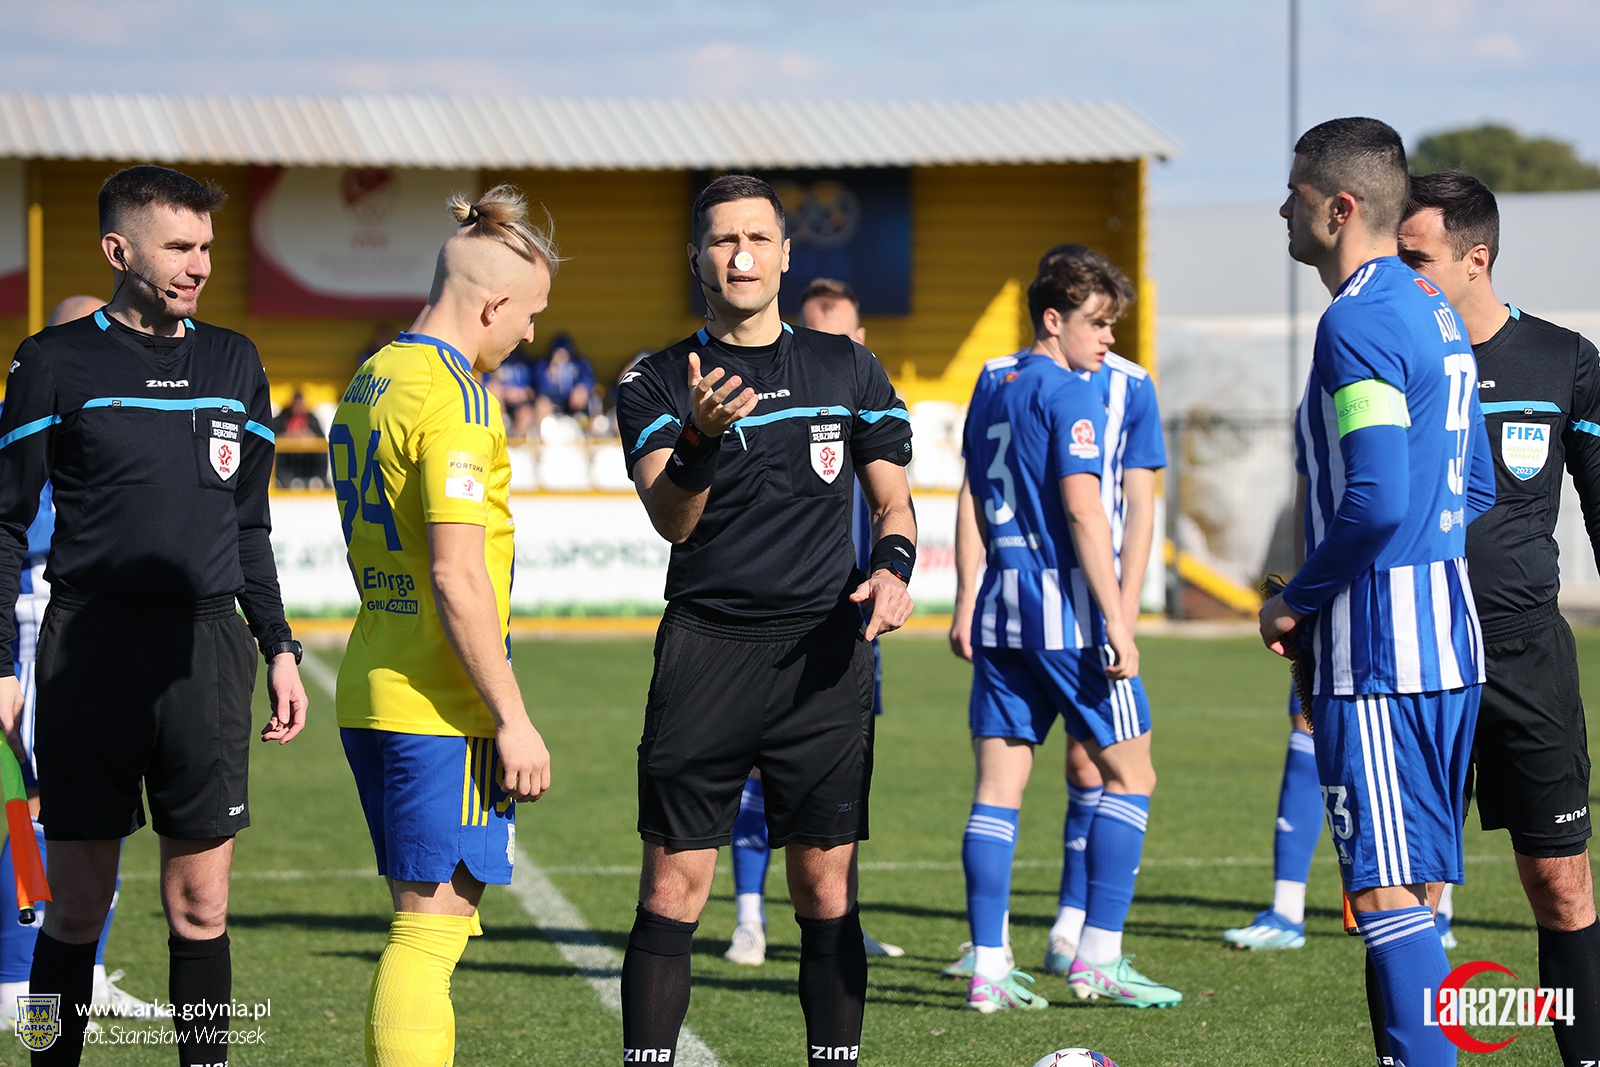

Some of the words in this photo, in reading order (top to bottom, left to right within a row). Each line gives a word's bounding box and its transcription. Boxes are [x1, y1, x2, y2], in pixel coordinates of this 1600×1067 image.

[146, 379, 189, 388] zina
[758, 389, 790, 400] ina
[1338, 399, 1370, 418] RESPECT
[1507, 426, 1544, 442] FIFA
[1506, 446, 1544, 454] ASSISTANT
[1508, 452, 1541, 460] REFEREE
[450, 462, 484, 473] FORTUNA
[985, 422, 1016, 525] 3
[1515, 467, 1533, 475] 2023
[388, 601, 417, 613] ORLEN
[1554, 806, 1587, 824] zina
[623, 1048, 672, 1063] zina
[811, 1045, 859, 1060] zina
